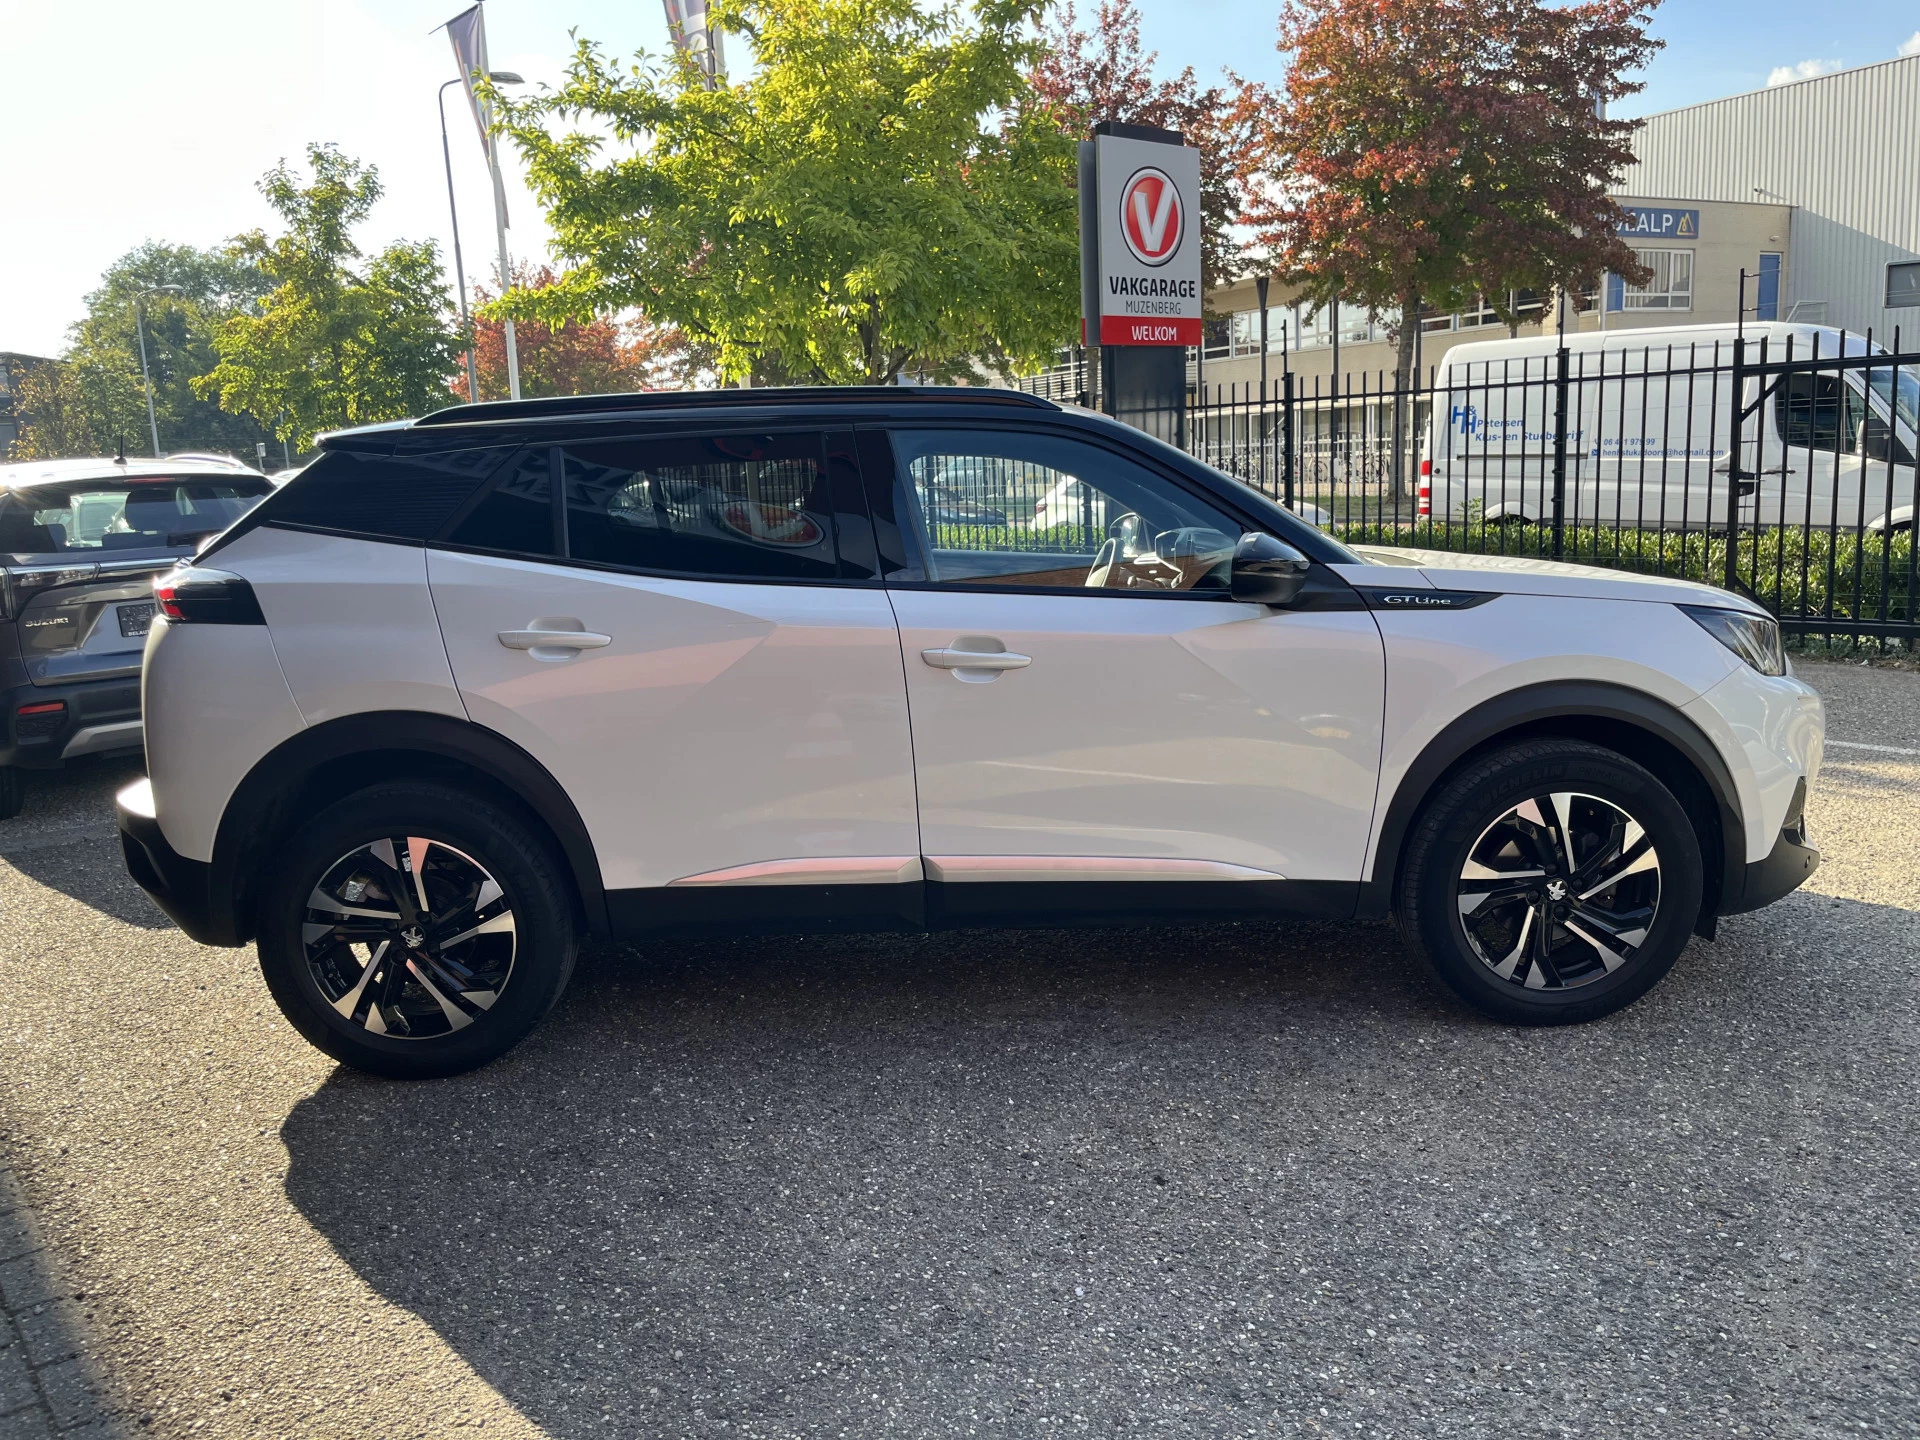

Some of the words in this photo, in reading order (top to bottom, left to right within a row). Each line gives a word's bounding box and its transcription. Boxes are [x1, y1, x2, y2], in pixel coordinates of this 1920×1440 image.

[1109, 276, 1196, 299] VAKGARAGE
[1125, 300, 1182, 315] MUZENBERG
[1131, 326, 1177, 341] WELKOM
